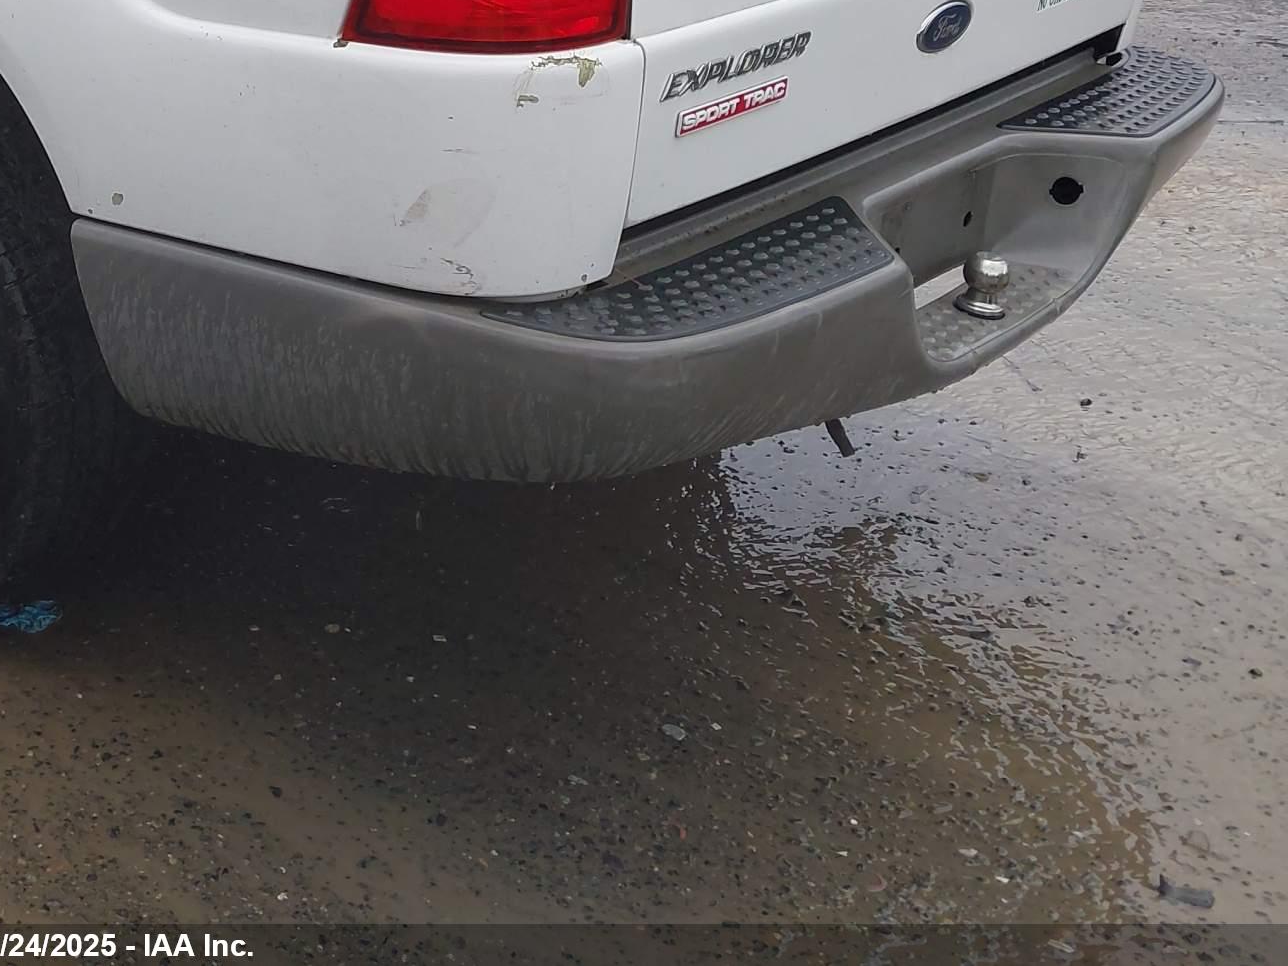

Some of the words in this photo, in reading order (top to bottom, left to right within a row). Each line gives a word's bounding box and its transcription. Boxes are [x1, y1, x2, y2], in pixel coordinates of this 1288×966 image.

[932, 13, 962, 41] Ford
[659, 31, 812, 102] EXPLORER
[682, 98, 740, 131] SPORT
[743, 82, 786, 109] TRAC
